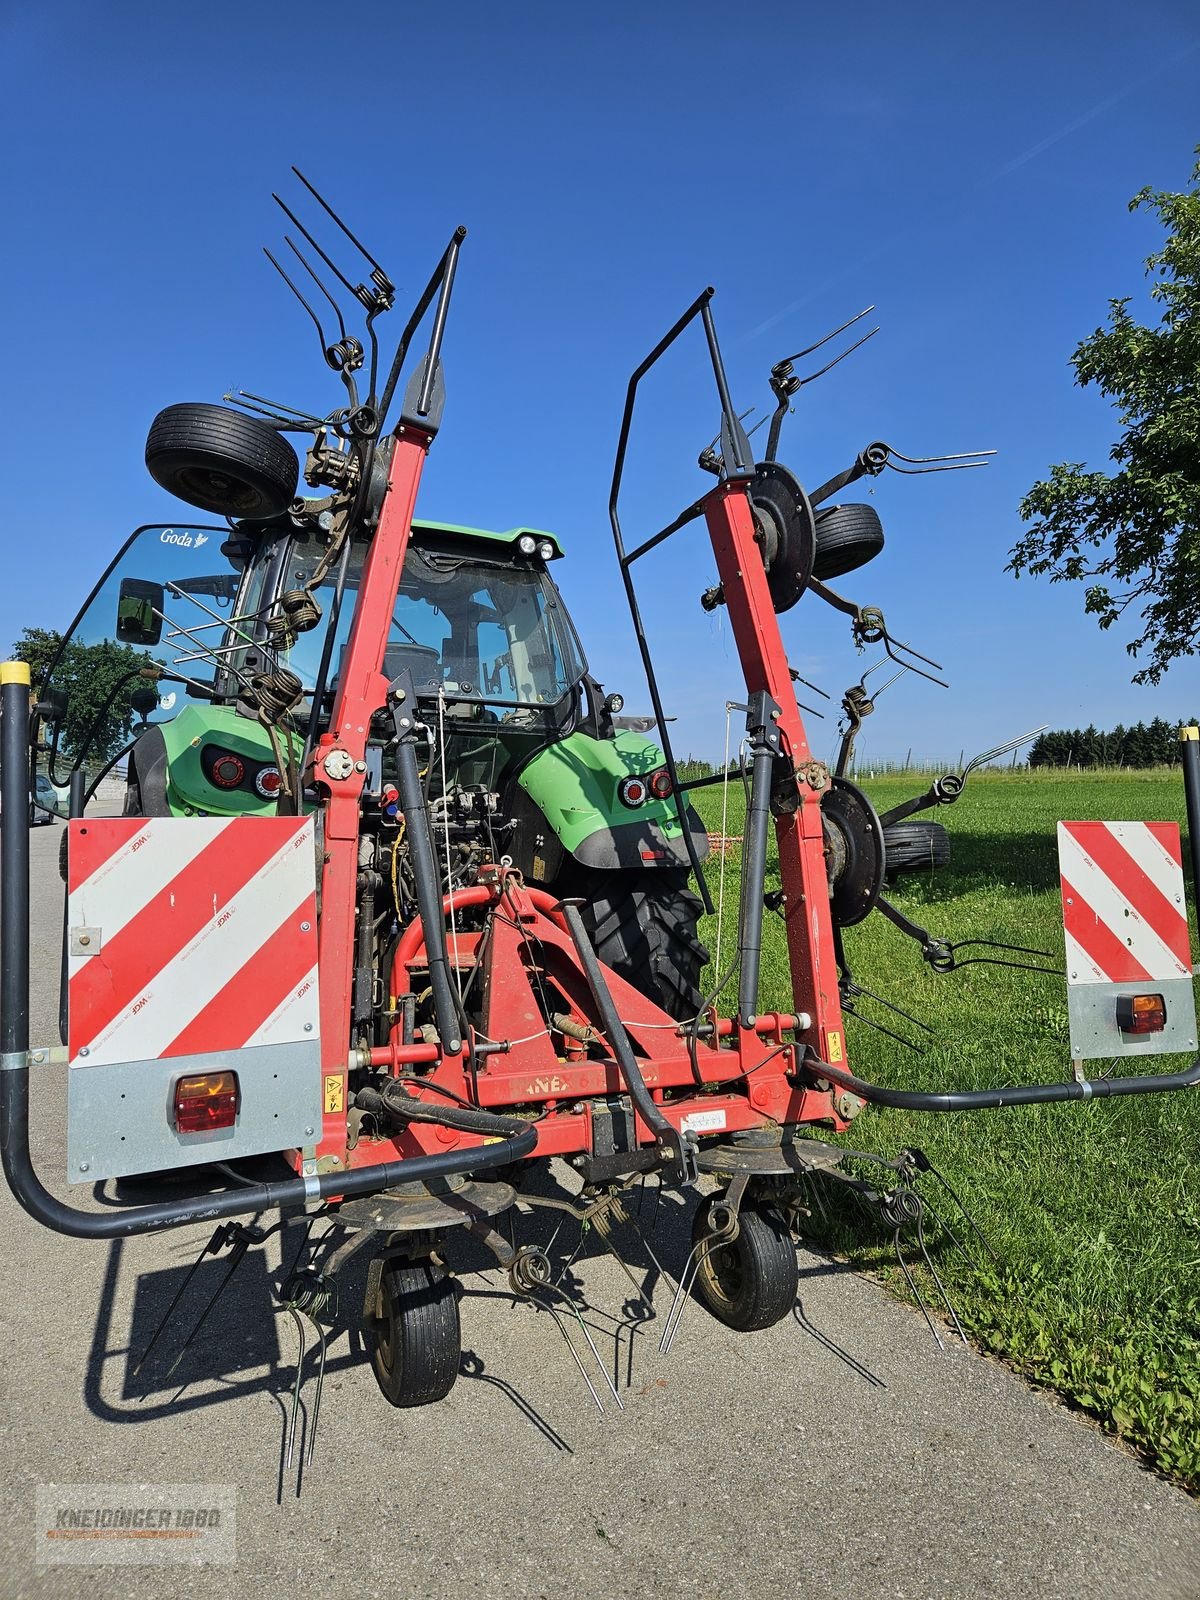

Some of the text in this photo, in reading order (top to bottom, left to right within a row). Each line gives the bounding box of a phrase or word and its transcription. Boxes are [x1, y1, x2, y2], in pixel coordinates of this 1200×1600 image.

[160, 528, 193, 548] Goda
[131, 835, 148, 853] WGF
[216, 911, 232, 928] WGF
[297, 982, 311, 999] WGF
[132, 997, 148, 1015] WGF
